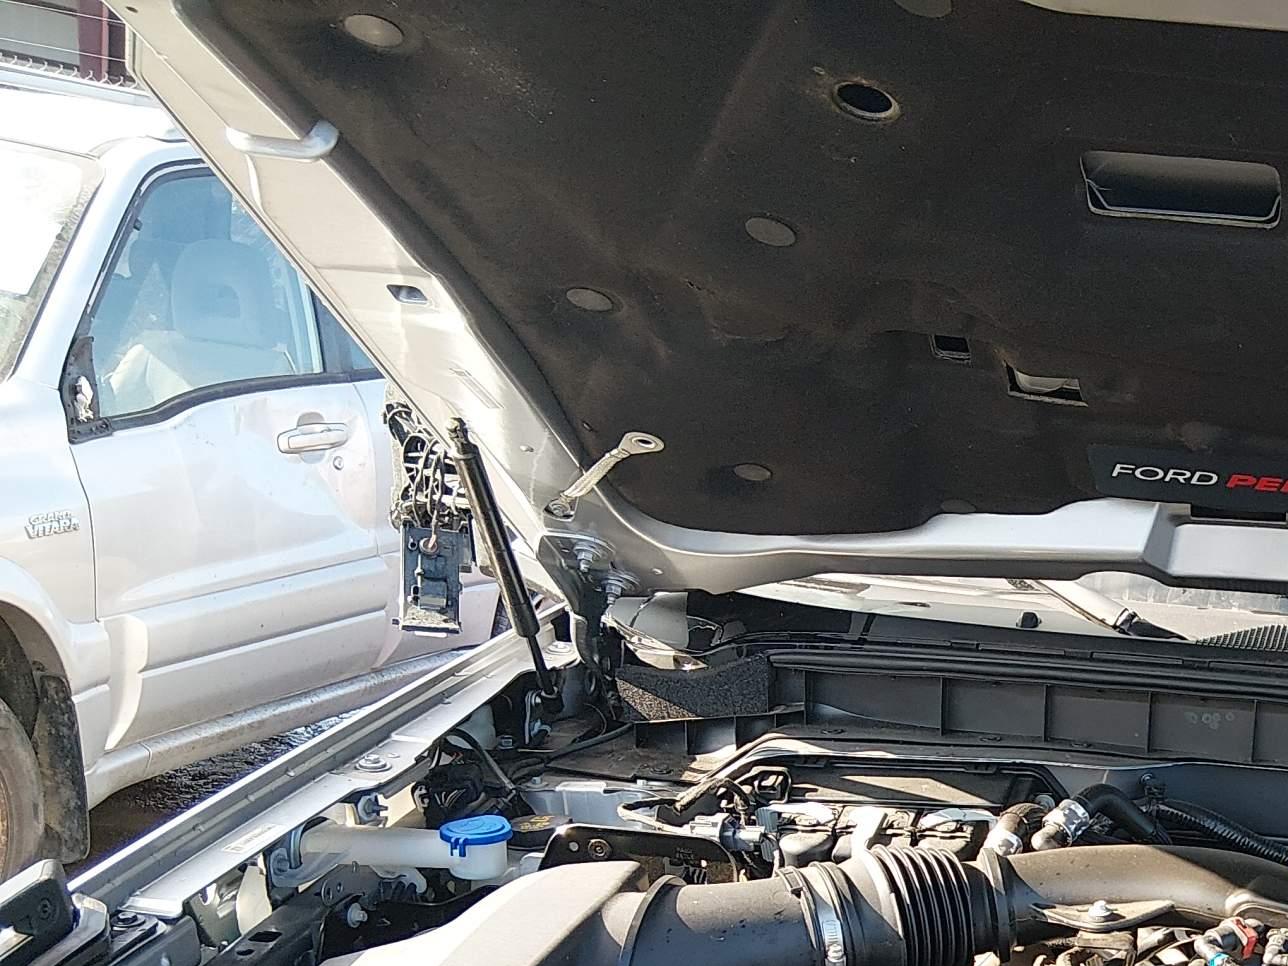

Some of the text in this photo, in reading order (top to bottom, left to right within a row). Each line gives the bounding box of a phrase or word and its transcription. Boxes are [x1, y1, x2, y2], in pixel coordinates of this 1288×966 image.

[1111, 463, 1218, 486] FORD
[28, 510, 72, 525] GRAND
[24, 518, 80, 539] VITARA
